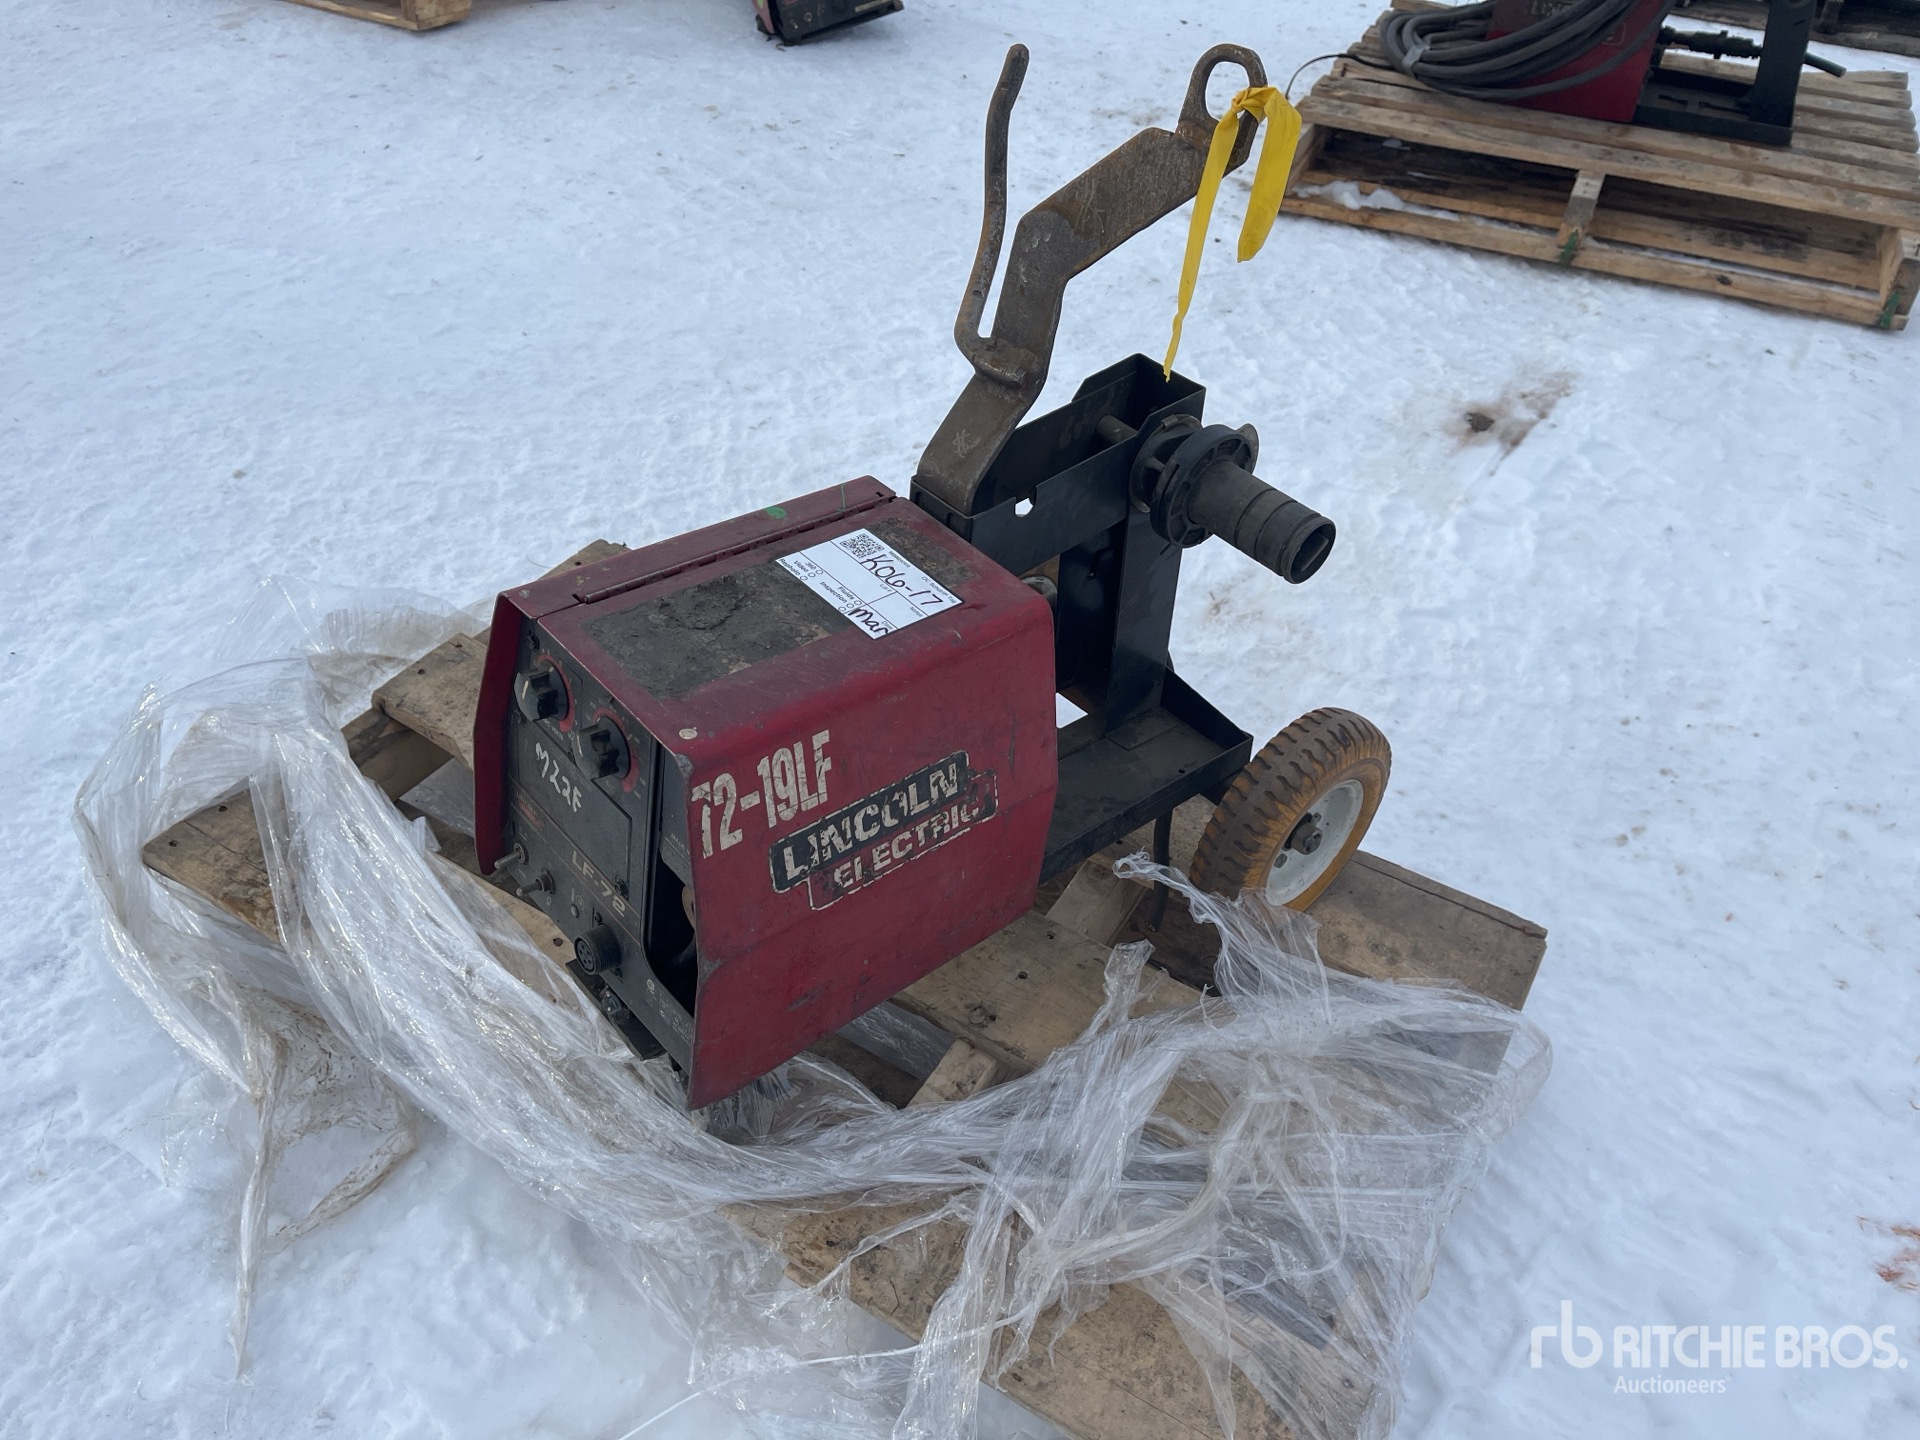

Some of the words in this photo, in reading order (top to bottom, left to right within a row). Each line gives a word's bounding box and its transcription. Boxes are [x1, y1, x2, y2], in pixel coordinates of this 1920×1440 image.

[819, 581, 848, 604] Inspection
[837, 586, 856, 602] Fluids
[860, 554, 944, 606] K06-17
[691, 730, 832, 859] 72-19LF
[783, 762, 958, 881] LINCOLN
[834, 796, 979, 888] ELECTRIC
[571, 850, 625, 917] LF-72
